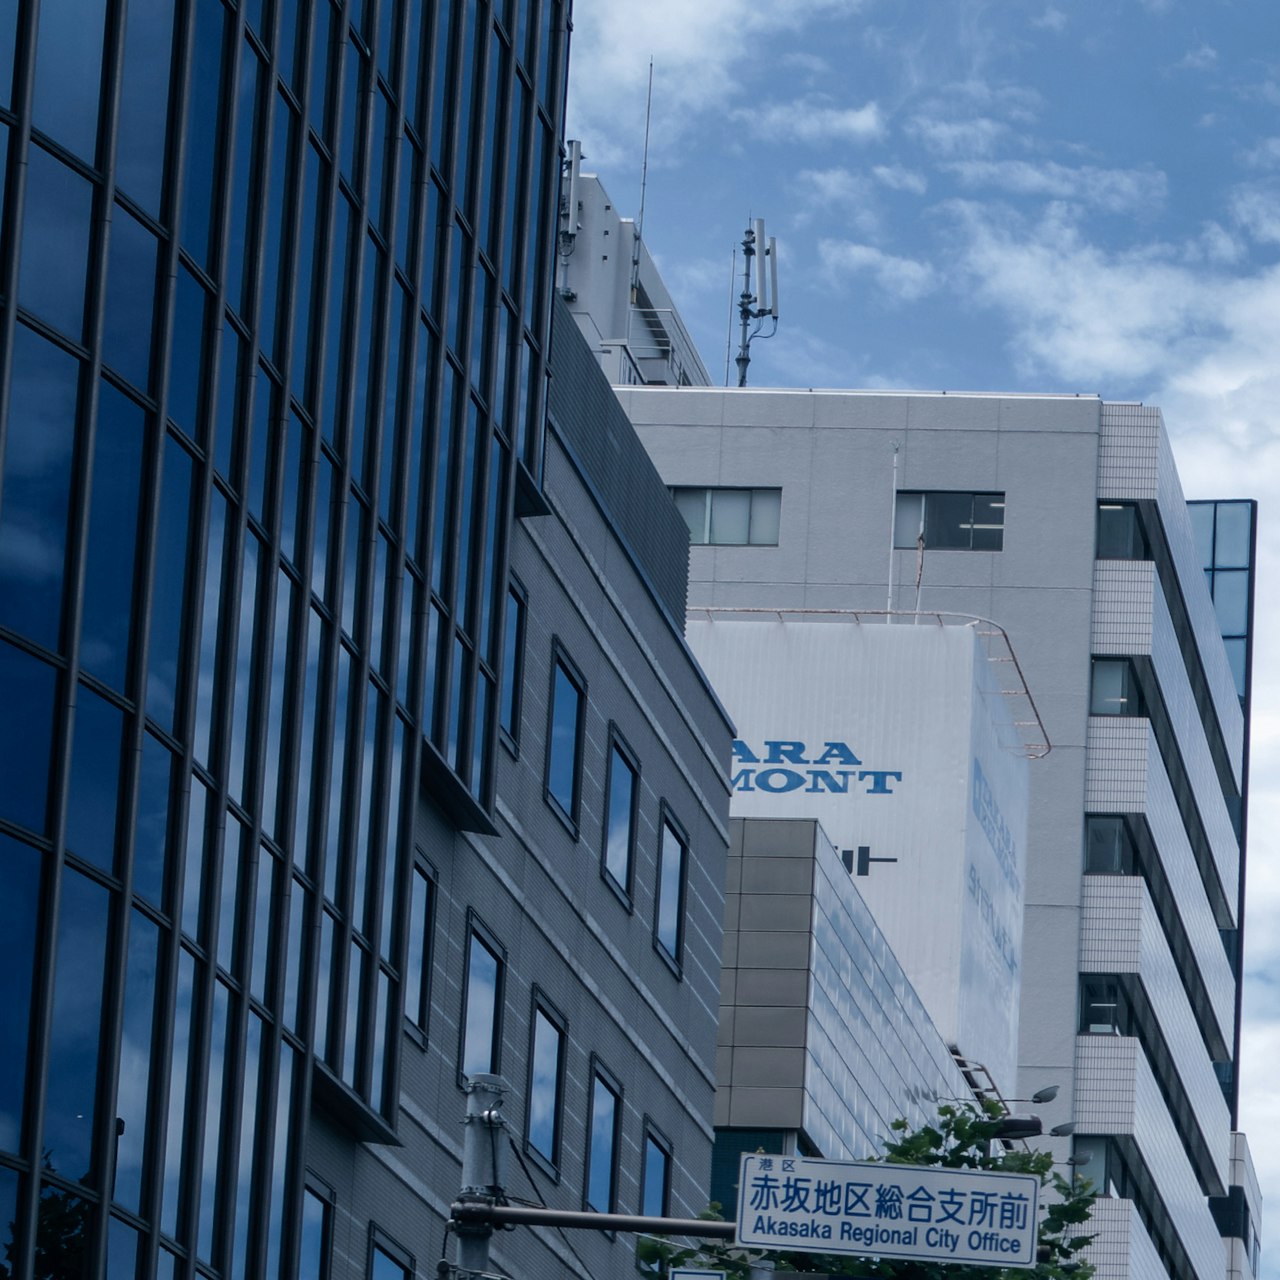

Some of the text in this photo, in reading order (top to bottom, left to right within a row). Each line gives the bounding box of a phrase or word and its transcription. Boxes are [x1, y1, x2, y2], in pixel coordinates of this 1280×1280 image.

[758, 1158, 796, 1174] 港区
[750, 1173, 1029, 1231] 赤坂地区総合支所前
[753, 1215, 1022, 1254] Akasaka Regional City Office
